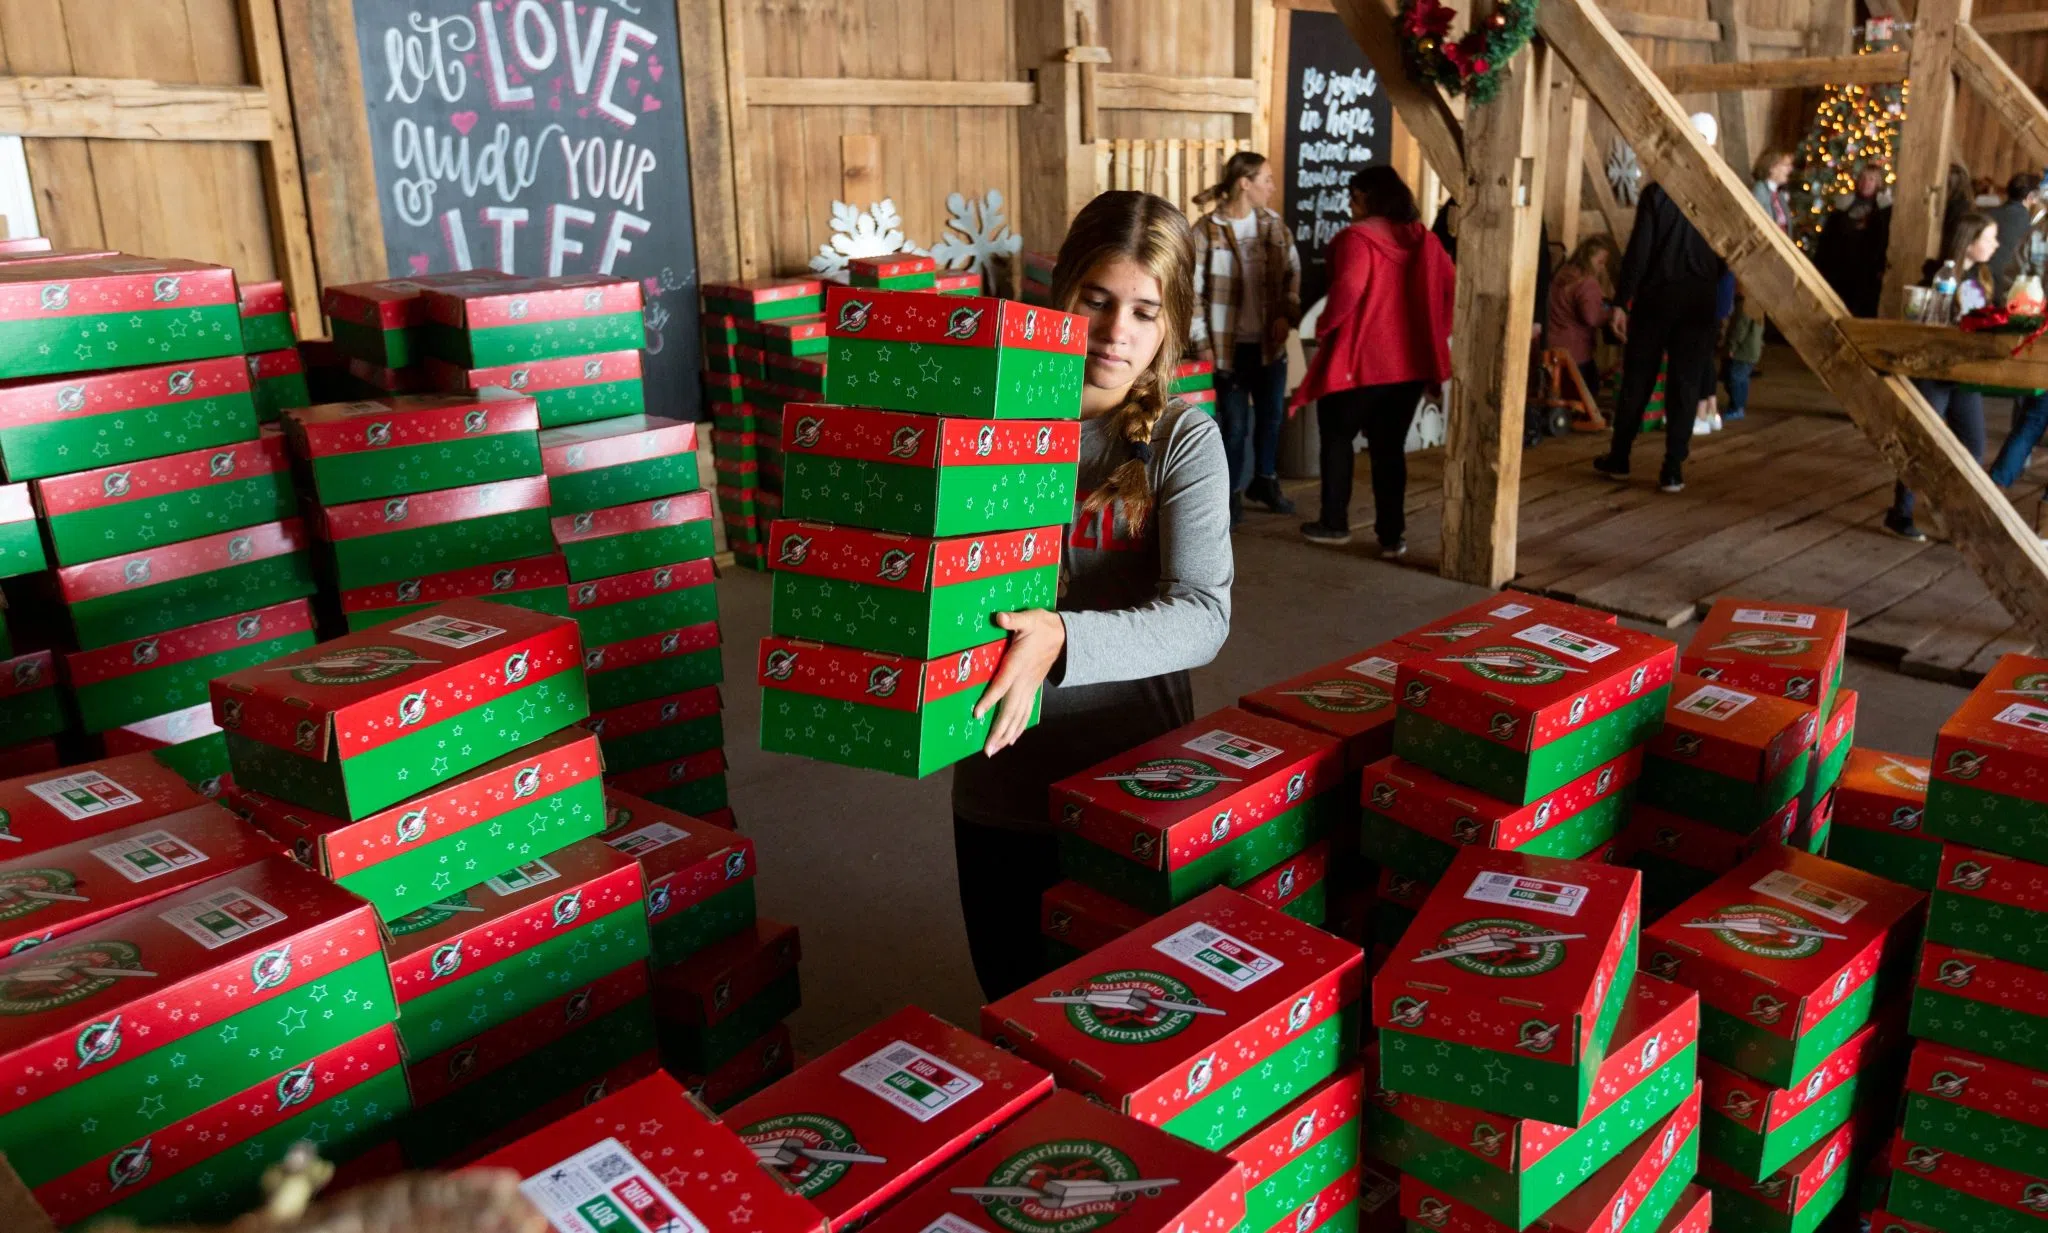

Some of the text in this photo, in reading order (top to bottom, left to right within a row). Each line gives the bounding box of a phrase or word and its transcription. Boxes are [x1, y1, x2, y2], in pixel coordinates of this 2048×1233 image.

[385, 0, 658, 127] let LOVE
[1299, 102, 1323, 133] in
[393, 118, 656, 227] guide YOUR
[1512, 889, 1536, 899] BOY
[1519, 880, 1544, 890] GIRL
[1217, 940, 1241, 954] GIRL
[1200, 951, 1224, 964] BOY
[1089, 981, 1165, 996] OPERATION
[1075, 1004, 1190, 1042] Samaritan's Purse
[911, 1060, 938, 1076] GIRL
[889, 1074, 916, 1089] BOY
[992, 1143, 1129, 1187] Samaritan's Purse
[619, 1179, 654, 1209] GIRL
[585, 1200, 620, 1228] BOY
[1022, 1201, 1116, 1220] OPERATION
[1059, 1215, 1098, 1233] Child
